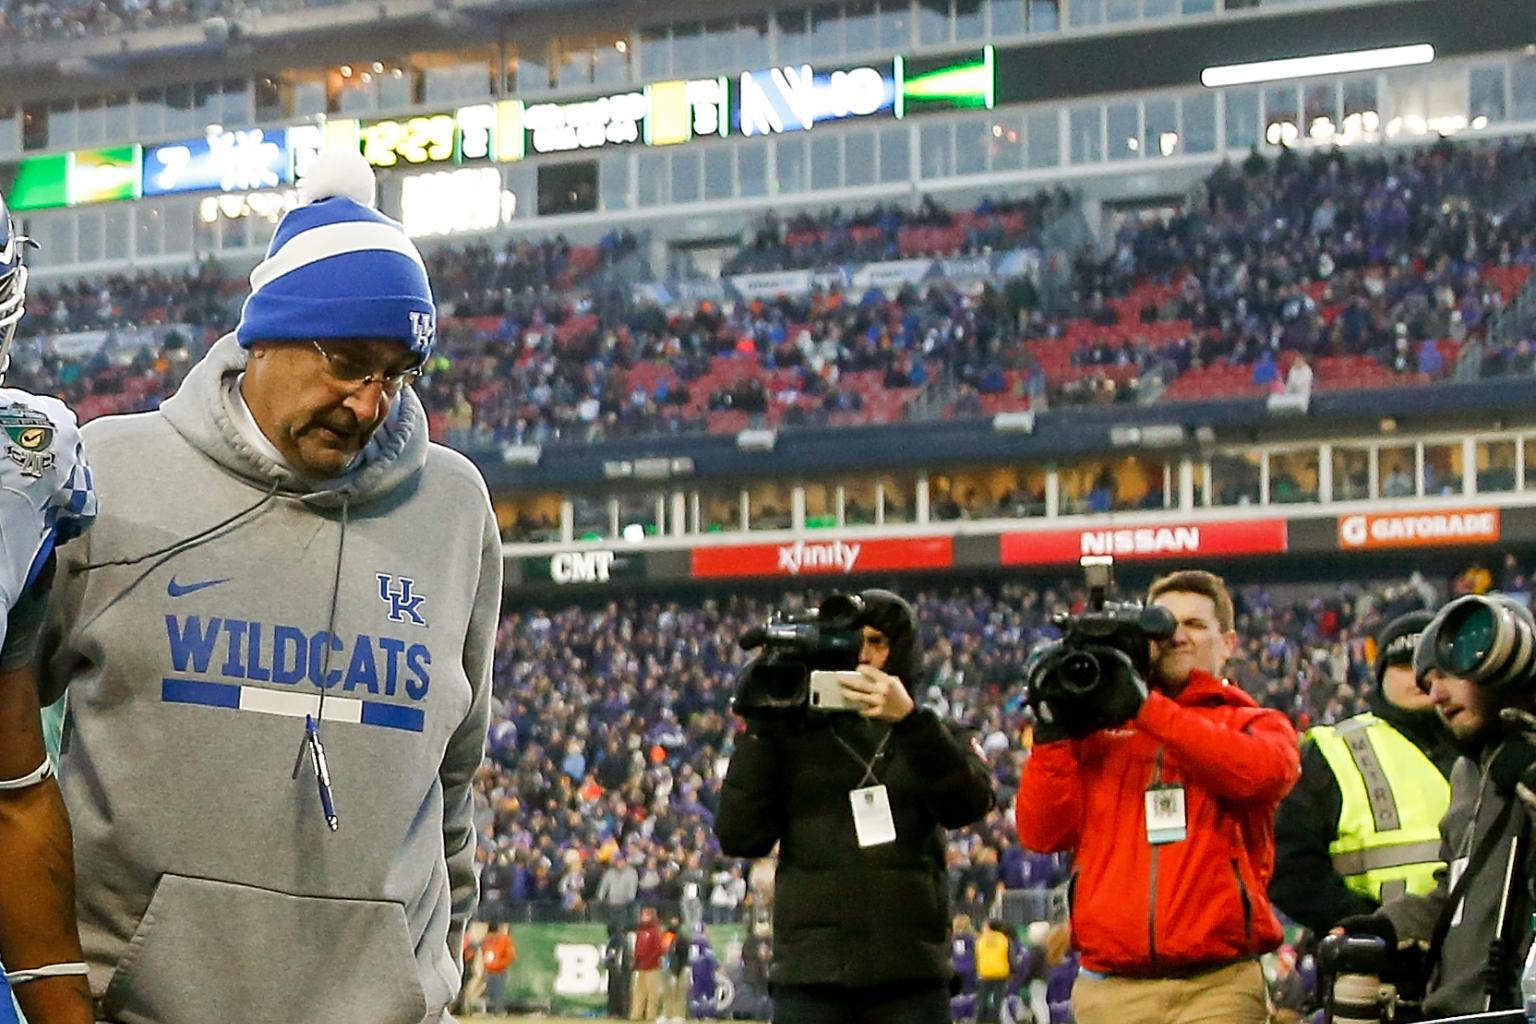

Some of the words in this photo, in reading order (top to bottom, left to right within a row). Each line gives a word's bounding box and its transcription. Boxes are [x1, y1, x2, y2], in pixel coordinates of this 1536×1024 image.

[157, 146, 191, 189] 7
[1080, 526, 1200, 555] NISSAN
[1371, 511, 1495, 541] GATORADE
[550, 551, 615, 584] CMT
[777, 540, 861, 575] xfinity
[375, 571, 427, 625] UK
[164, 614, 432, 701] WILDCATS
